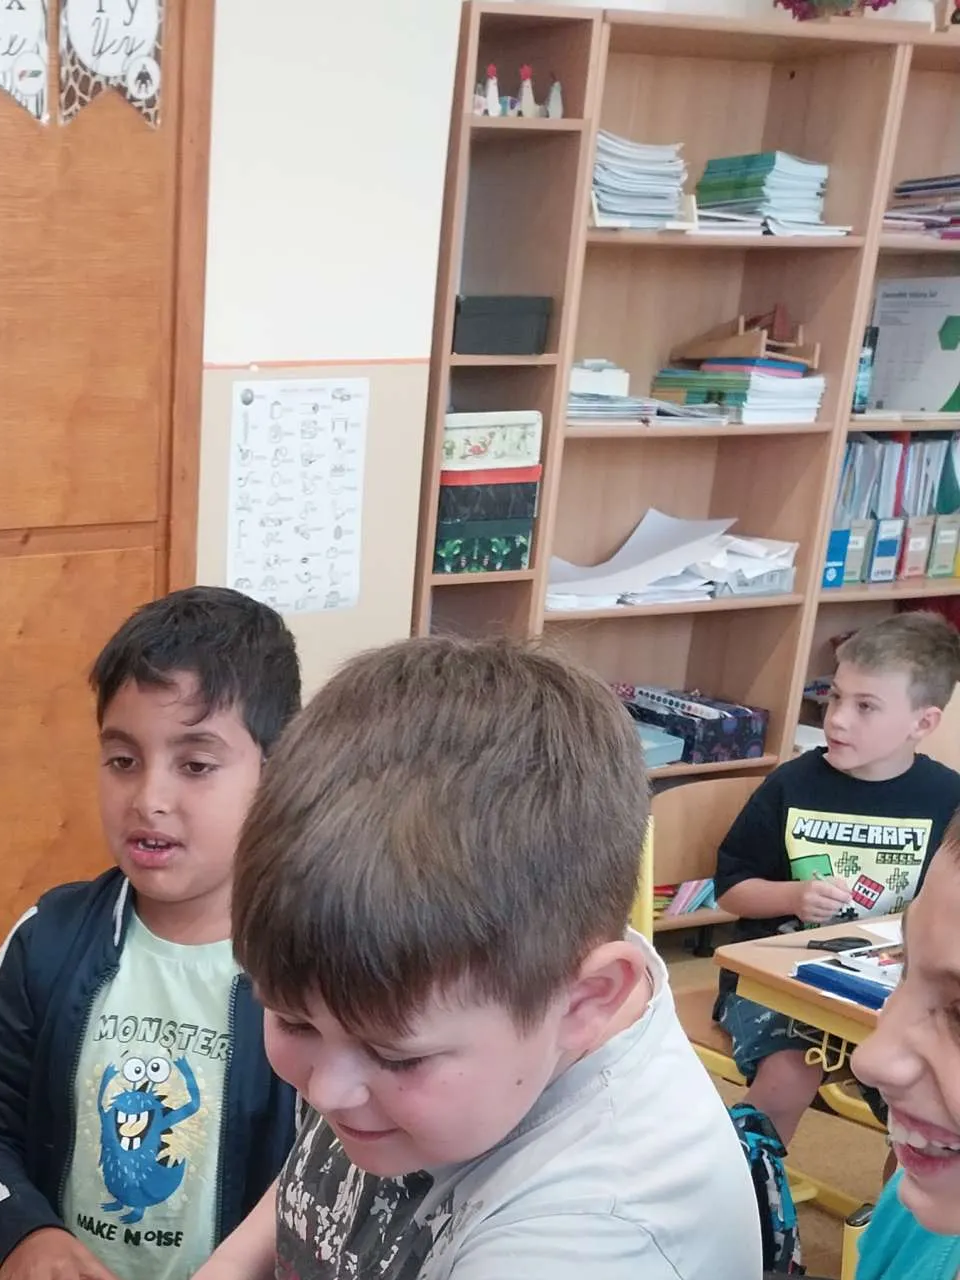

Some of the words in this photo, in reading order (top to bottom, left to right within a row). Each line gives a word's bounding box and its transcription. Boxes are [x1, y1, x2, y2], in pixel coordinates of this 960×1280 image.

[792, 816, 928, 852] MINECRAFT
[855, 883, 879, 900] TNT
[76, 1213, 118, 1241] MAKE
[123, 1227, 184, 1247] NOISE
